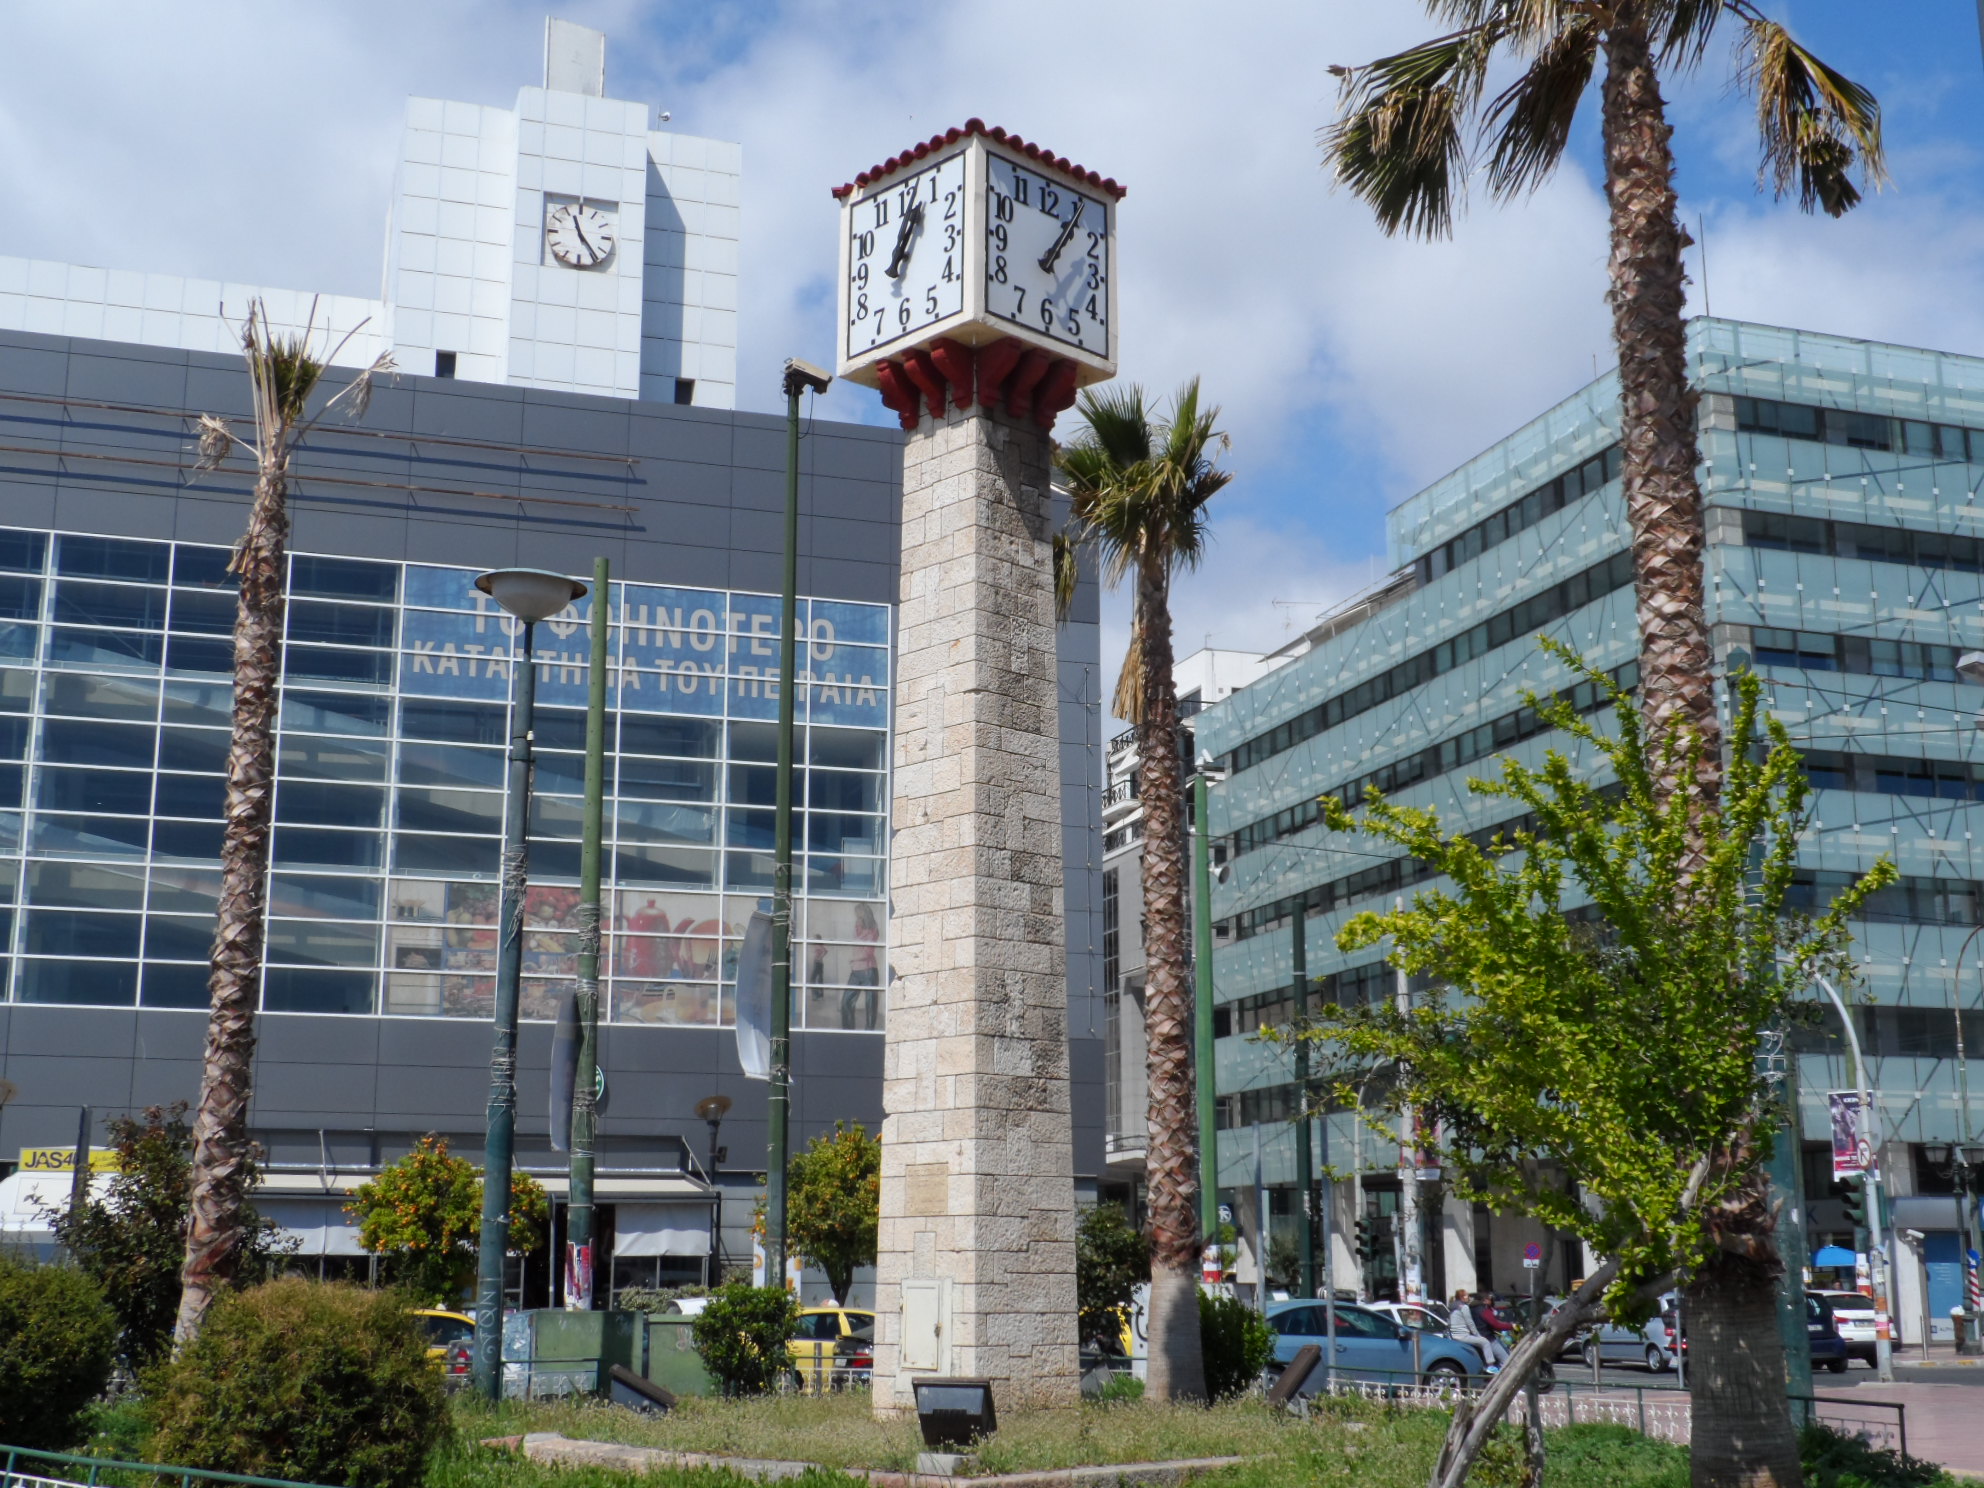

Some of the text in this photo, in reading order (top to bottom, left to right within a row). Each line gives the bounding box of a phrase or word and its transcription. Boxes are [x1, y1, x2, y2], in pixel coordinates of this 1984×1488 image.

[928, 175, 938, 204] 1
[1012, 175, 1029, 206] 11
[1039, 186, 1060, 219] 12
[874, 199, 889, 229] 11
[944, 191, 956, 221] 2
[994, 192, 1014, 223] 10
[856, 230, 875, 261] 10
[944, 224, 956, 253] 3
[994, 224, 1008, 252] 9
[1086, 231, 1099, 261] 2
[857, 263, 869, 291] 9
[941, 255, 954, 284] 4
[994, 255, 1008, 284] 8
[1086, 262, 1099, 290] 3
[856, 292, 869, 321] 8
[898, 298, 911, 326] 6
[925, 285, 938, 315] 5
[1013, 285, 1026, 314] 7
[1040, 298, 1053, 326] 6
[1085, 294, 1098, 321] 4
[873, 307, 886, 337] 7
[1068, 308, 1081, 337] 5
[412, 639, 877, 707] ΚΑΤΑΤΗΑ ΤΟΥ ΠΕΡΑΙΑ
[24, 1151, 77, 1169] JAS4
